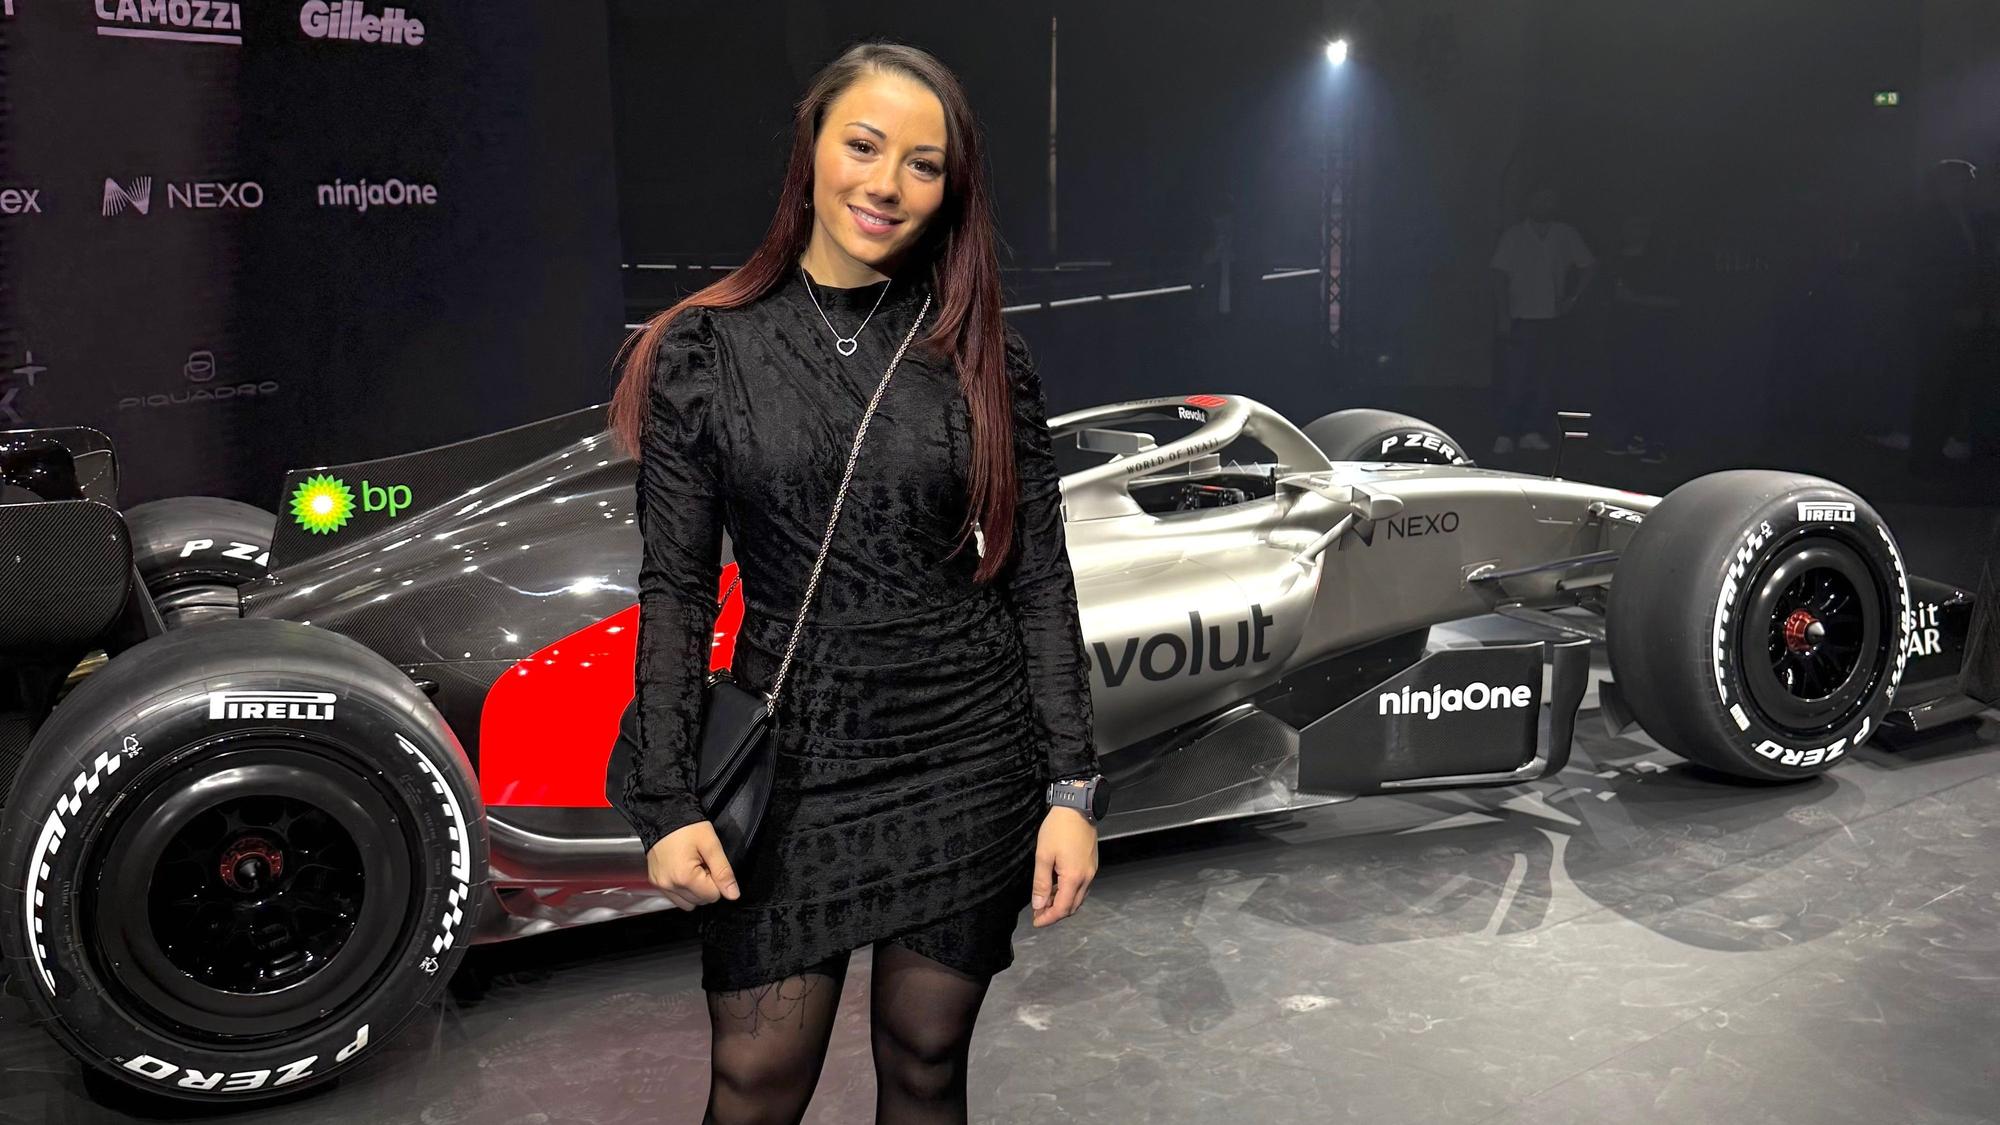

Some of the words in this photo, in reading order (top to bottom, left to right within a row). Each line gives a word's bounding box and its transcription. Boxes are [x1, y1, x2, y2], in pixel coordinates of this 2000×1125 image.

[95, 0, 241, 31] CAMOZZI
[300, 0, 425, 46] Gillette
[0, 189, 42, 214] ex
[167, 182, 264, 208] NEXO
[318, 178, 438, 212] ninjaOne
[118, 381, 279, 410] PIQUADRO
[1382, 436, 1399, 455] P
[1126, 455, 1164, 474] WORLD
[1168, 450, 1182, 461] OF
[362, 480, 413, 518] bp
[1797, 501, 1856, 523] PIRELLI
[1387, 511, 1460, 540] NEXO
[180, 539, 214, 558] P
[1910, 601, 1940, 631] sit
[1086, 603, 1274, 688] volut
[1907, 628, 1942, 659] AR
[208, 690, 337, 720] PIRELLI
[1379, 682, 1532, 720] ninjaOne
[1853, 716, 1870, 745] P
[1754, 737, 1847, 767] ZERO
[335, 1024, 369, 1062] P
[123, 1054, 318, 1092] ZERO
